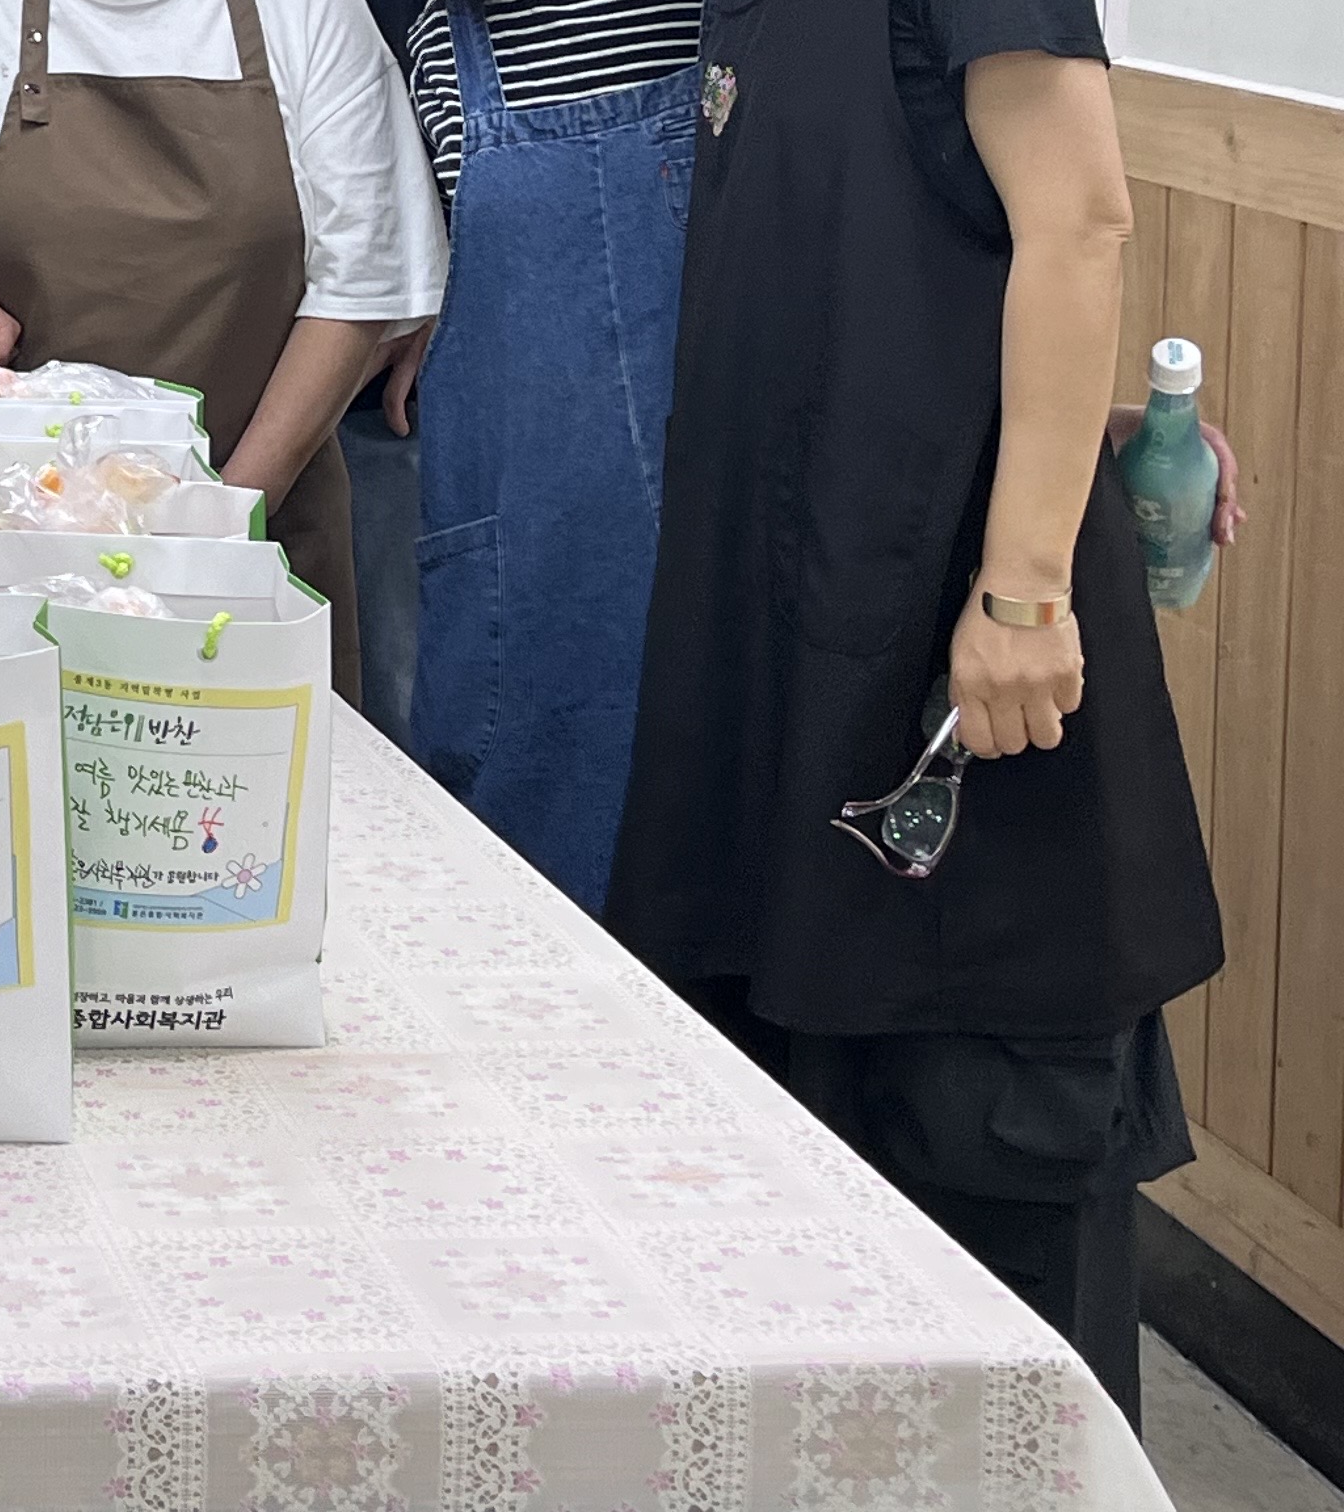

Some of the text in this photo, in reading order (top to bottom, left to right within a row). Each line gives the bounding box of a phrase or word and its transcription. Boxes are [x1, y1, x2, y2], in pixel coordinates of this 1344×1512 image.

[180, 690, 201, 700] 사업
[148, 716, 201, 746] 반찬
[70, 796, 91, 831] 잘
[115, 993, 146, 1005] 마을과
[150, 994, 170, 1005] 함께
[174, 993, 213, 1006] 상생하는
[215, 986, 234, 1002] 우리
